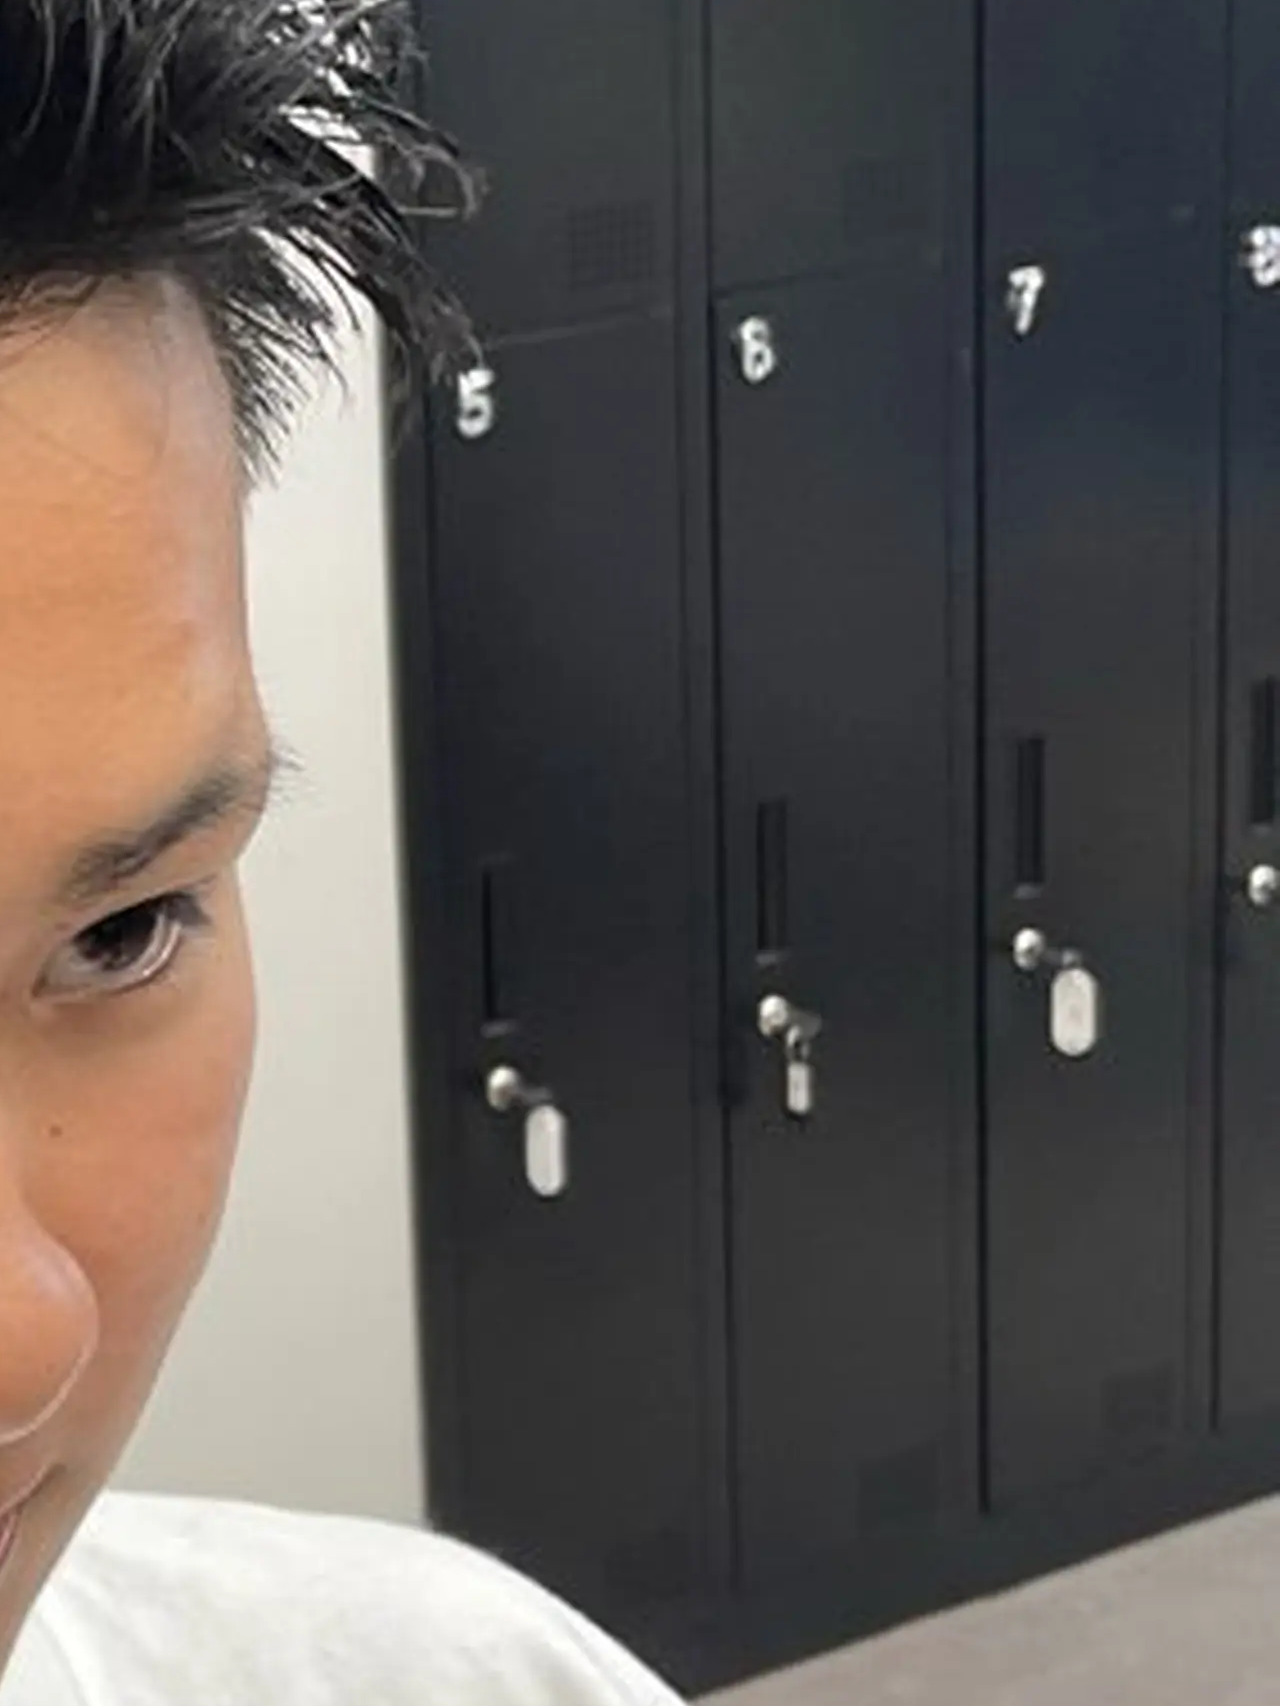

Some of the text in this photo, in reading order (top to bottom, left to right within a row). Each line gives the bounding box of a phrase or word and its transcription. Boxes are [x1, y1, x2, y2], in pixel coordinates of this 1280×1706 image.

[1008, 266, 1044, 334] 7
[739, 317, 775, 382] 6
[458, 368, 493, 438] 5
